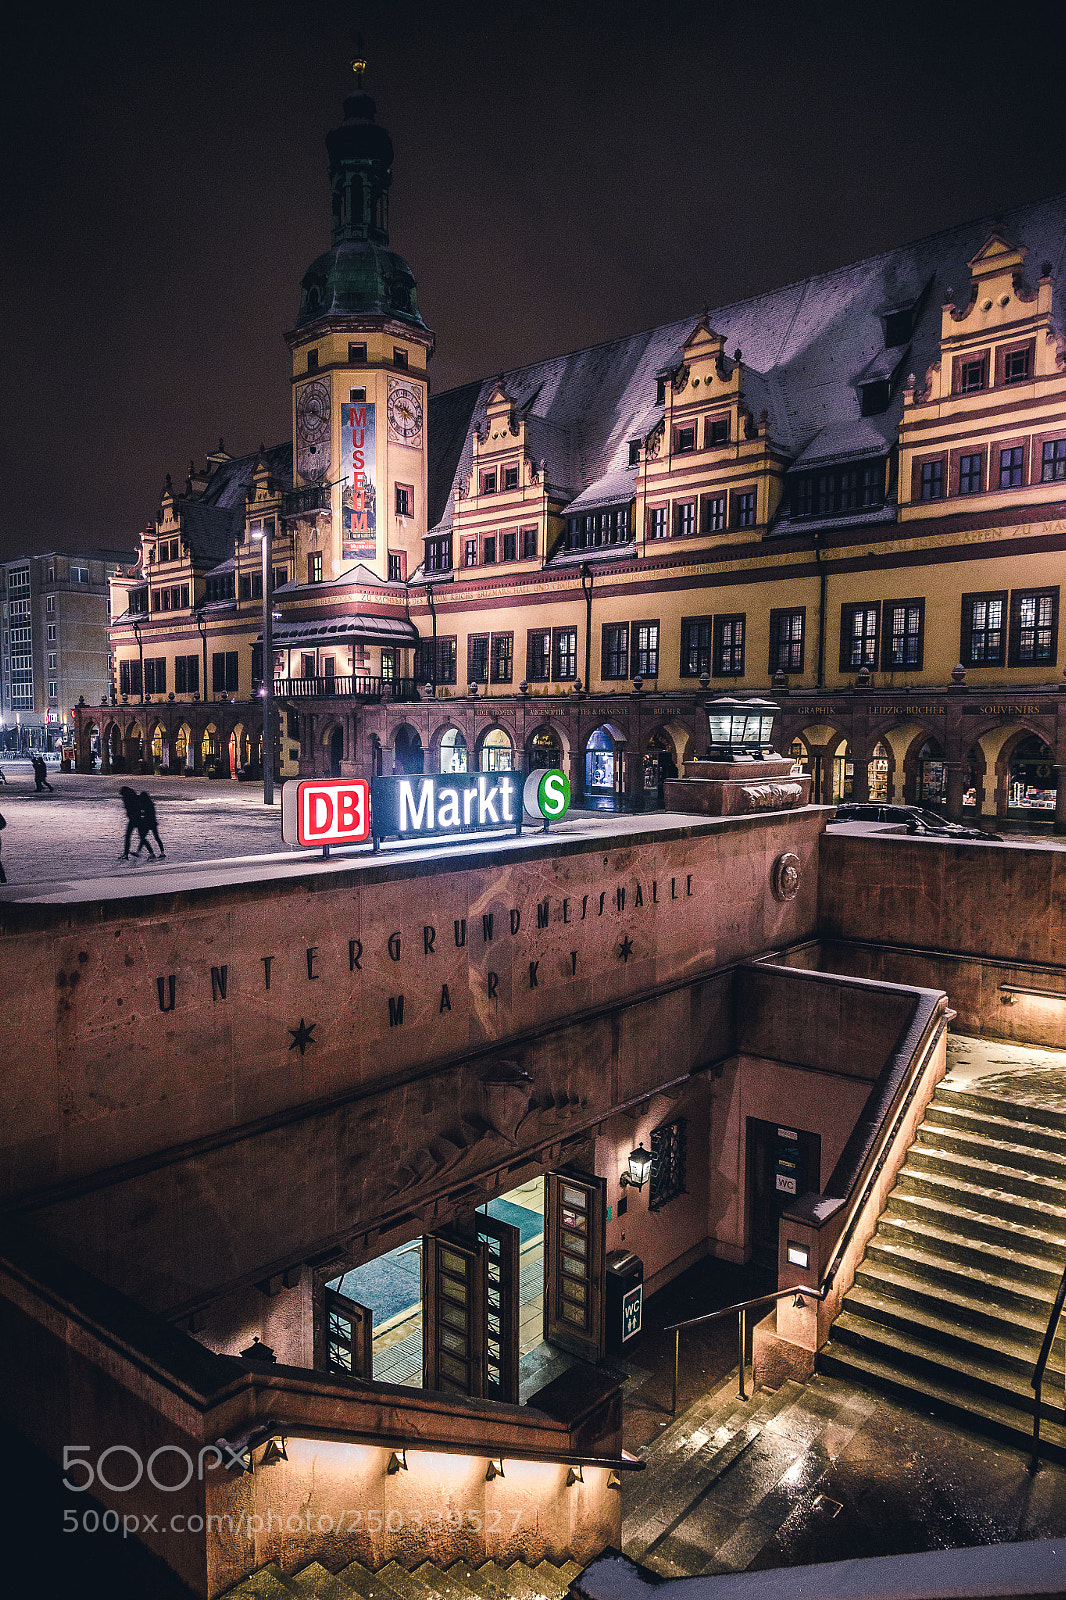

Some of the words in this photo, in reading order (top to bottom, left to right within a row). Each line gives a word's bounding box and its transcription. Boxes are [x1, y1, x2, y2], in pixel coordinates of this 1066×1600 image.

[349, 407, 368, 533] MUSEUM
[1012, 524, 1031, 536] ZU
[797, 706, 836, 714] GRAPHIK
[979, 704, 1040, 714] SOUVENIRS
[399, 776, 513, 831] Markt
[544, 775, 566, 815] S
[308, 790, 361, 835] DB
[388, 951, 578, 1027] MARKT
[779, 1177, 794, 1190] WC
[624, 1300, 640, 1319] WC
